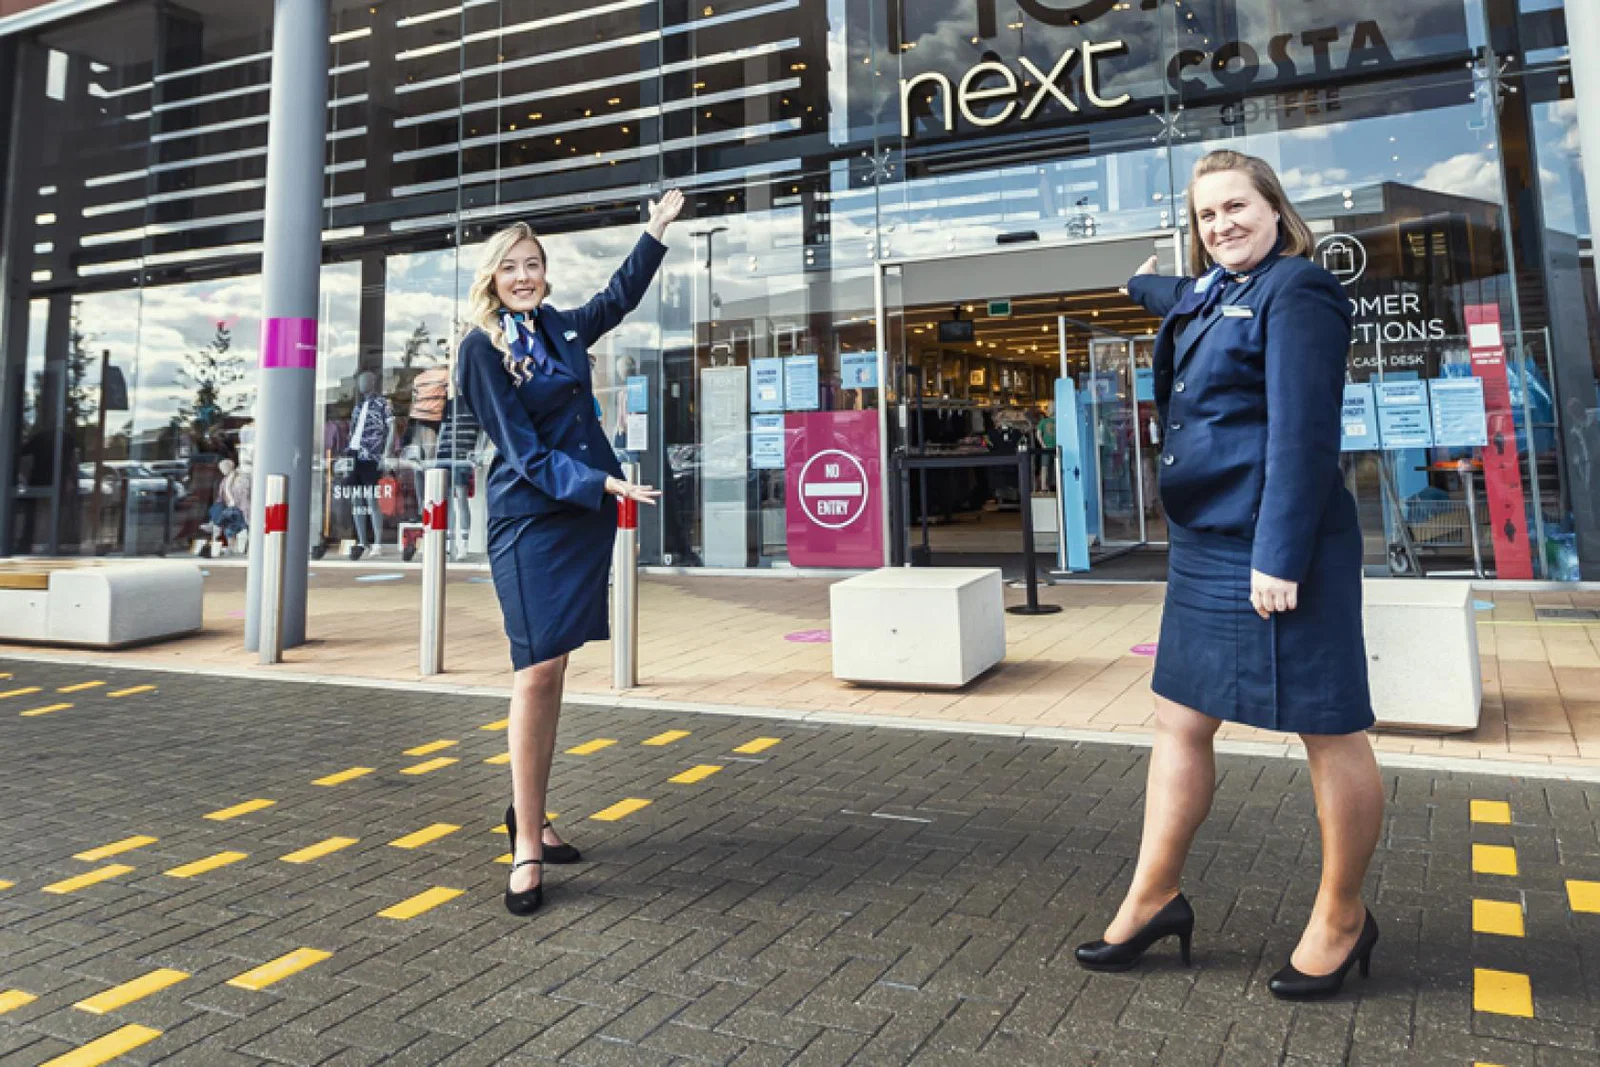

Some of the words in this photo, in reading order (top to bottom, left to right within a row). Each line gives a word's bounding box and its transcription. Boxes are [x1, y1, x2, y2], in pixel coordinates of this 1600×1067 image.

[1166, 20, 1396, 95] COSTA
[899, 39, 1131, 137] next
[1350, 317, 1446, 344] TIONS
[1352, 356, 1388, 369] CASH
[1390, 353, 1425, 367] DESK
[824, 463, 840, 479] NO
[333, 484, 393, 499] SUMMER
[817, 500, 850, 516] ENTRY
